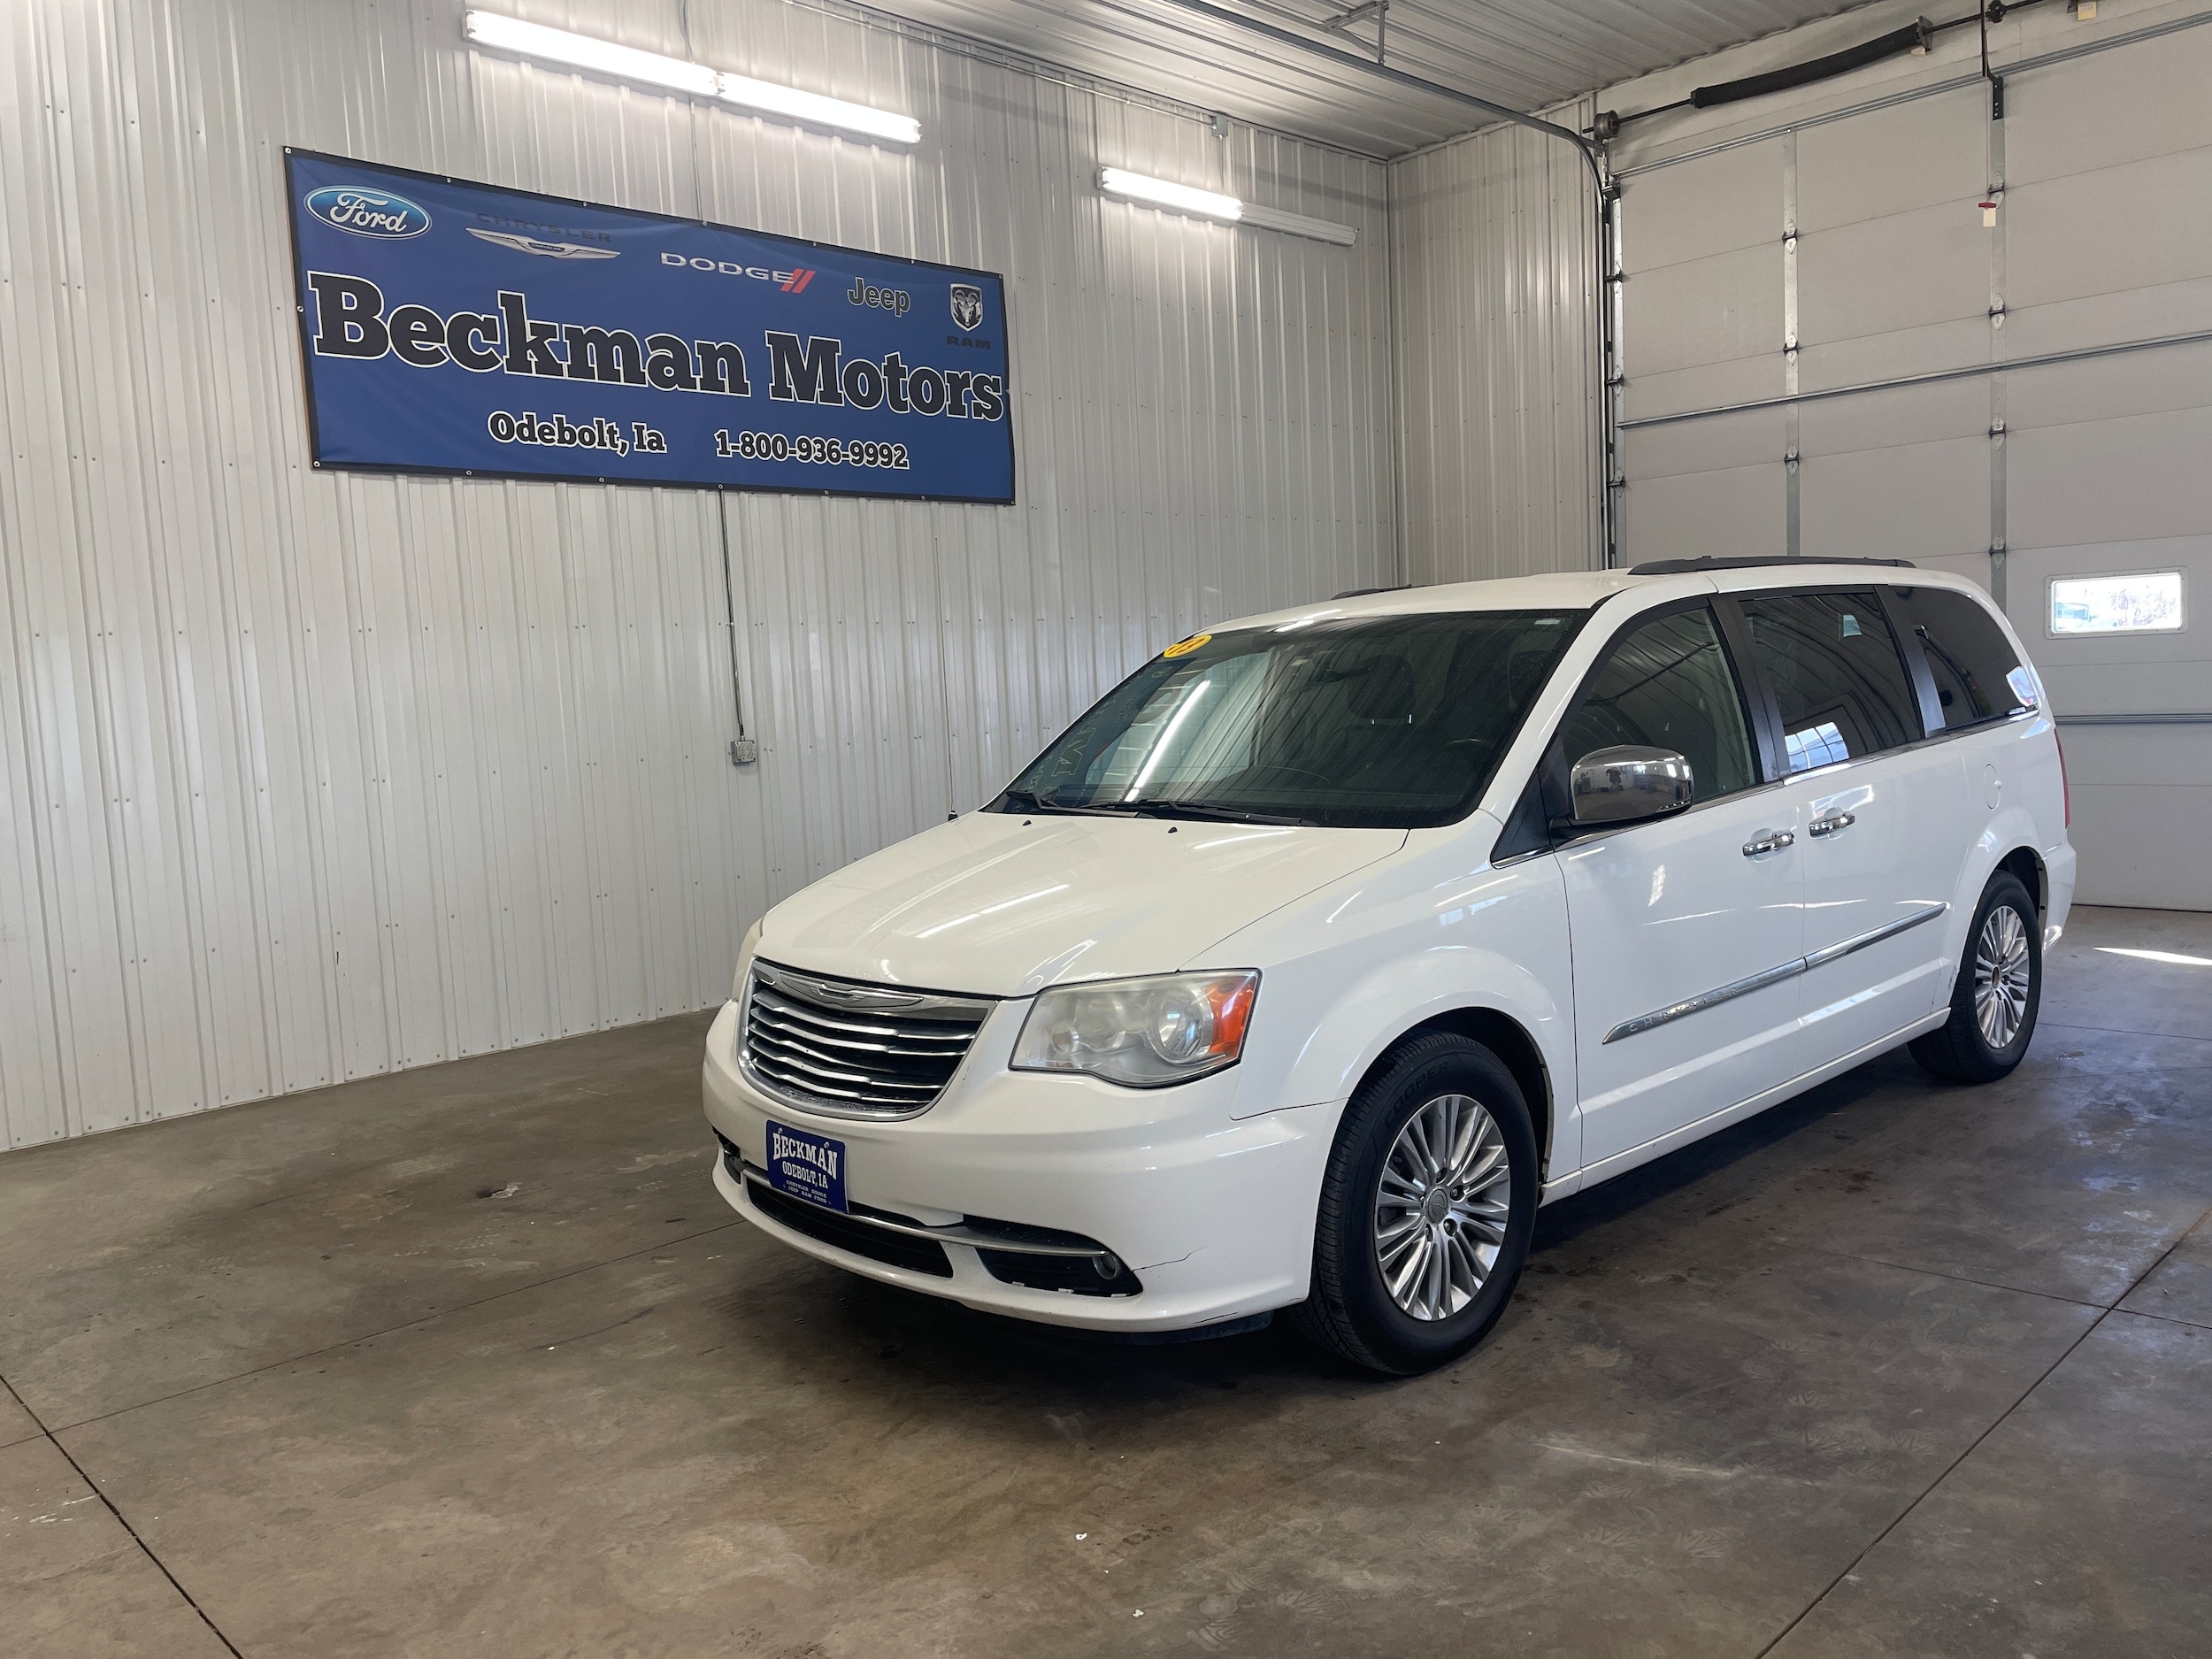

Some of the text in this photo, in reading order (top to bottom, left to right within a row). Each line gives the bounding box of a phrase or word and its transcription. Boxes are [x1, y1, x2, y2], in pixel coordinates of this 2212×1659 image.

[329, 193, 407, 232] Ford
[476, 213, 611, 242] CHRYSLER
[660, 251, 795, 285] DODGE
[847, 277, 911, 317] Jeep
[307, 270, 1004, 421] Beckman Motors
[947, 336, 991, 349] RAM
[488, 411, 667, 457] Odebolt, Ia
[714, 428, 910, 470] 1-800-936-9992
[1629, 987, 1737, 1032] CHRYSLER
[772, 1132, 838, 1180] BECKMAN
[782, 1161, 828, 1189] ODEBOLT, IA
